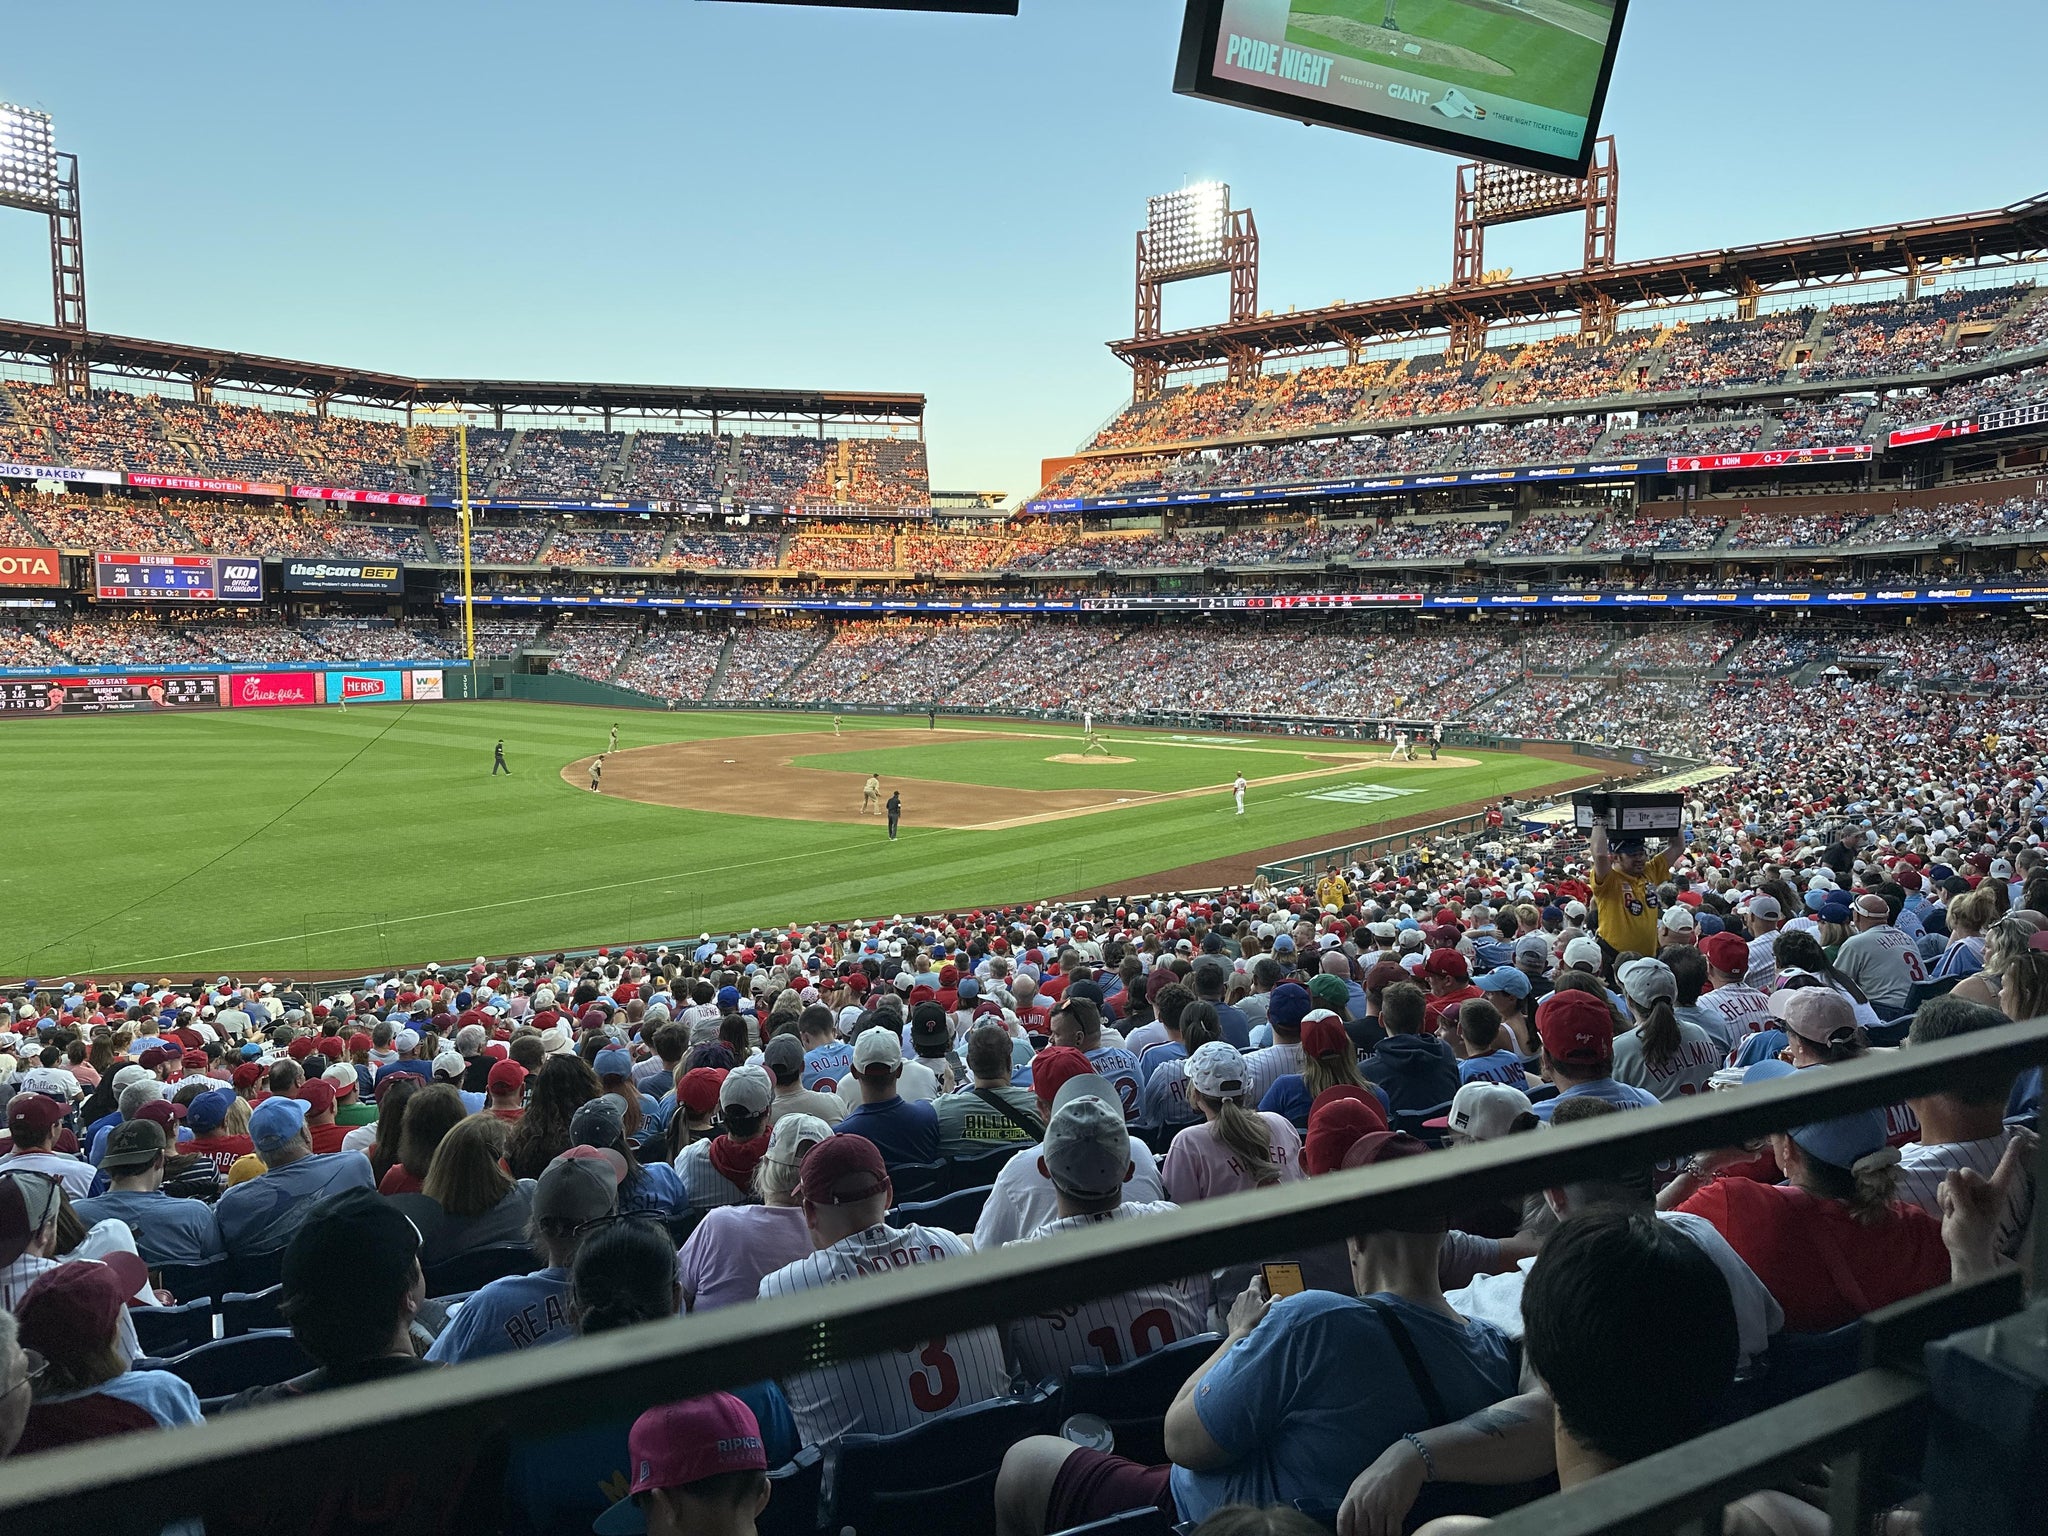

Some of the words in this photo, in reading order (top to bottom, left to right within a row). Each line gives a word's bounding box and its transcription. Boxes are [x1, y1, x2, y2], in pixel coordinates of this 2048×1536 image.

[1225, 33, 1280, 76] PRIDE
[1279, 46, 1334, 88] NIGHT
[1339, 75, 1374, 89] PRESENTED
[1387, 83, 1430, 105] GIANT
[1515, 117, 1532, 127] NIGHT
[1533, 121, 1551, 132] TICKET
[1552, 125, 1579, 138] REQUIRED
[1722, 456, 1741, 465] BOHM
[1764, 454, 1782, 463] 0-2
[1797, 455, 1813, 463] .204
[1854, 452, 1864, 460] 24
[36, 468, 85, 479] BAKERY
[134, 475, 163, 486] WHEY
[166, 478, 200, 489] BETTER
[203, 480, 242, 491] PROTEIN
[290, 563, 361, 577] theScore
[365, 568, 395, 578] BET
[165, 575, 175, 584] 24
[243, 676, 305, 701] Chick-fil-A
[347, 680, 380, 692] HERR'S
[1903, 951, 1925, 982] 3
[965, 1130, 1002, 1139] ELECTRIC
